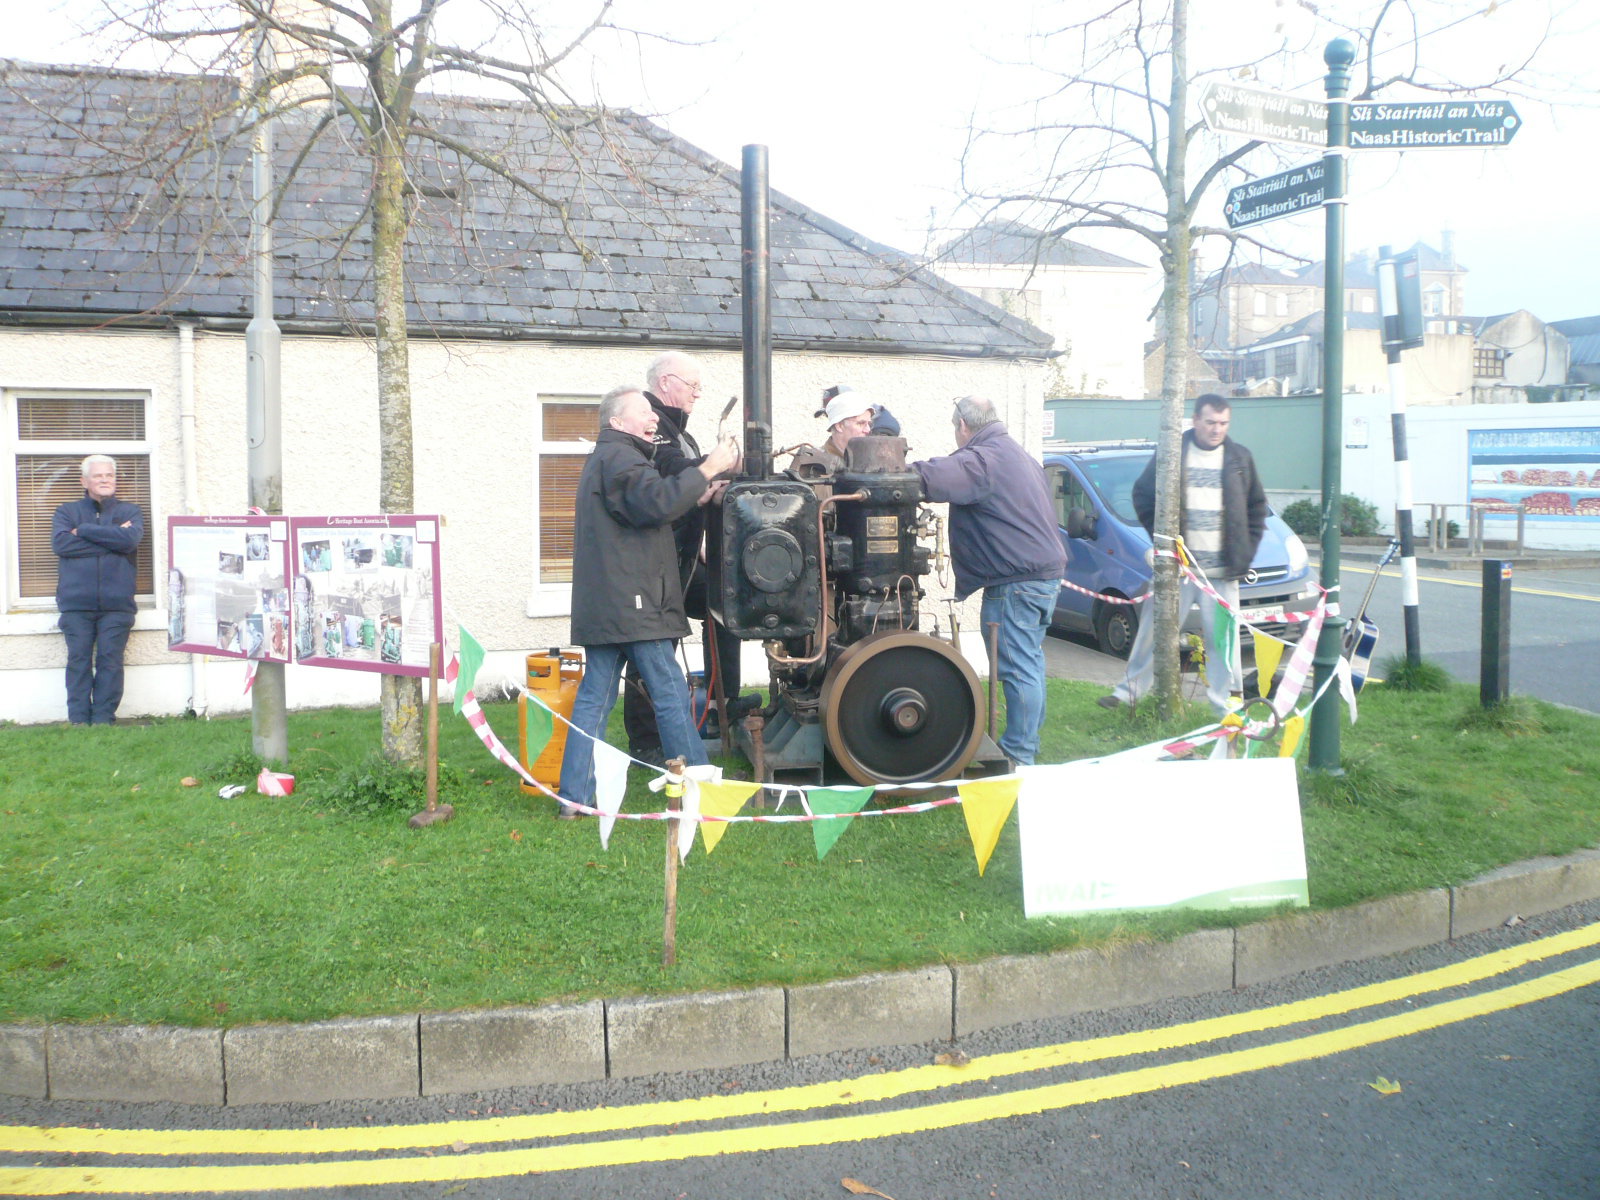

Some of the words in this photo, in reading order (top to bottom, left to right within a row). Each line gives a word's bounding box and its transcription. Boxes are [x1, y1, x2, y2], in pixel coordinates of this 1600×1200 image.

[1289, 103, 1305, 116] an
[1448, 106, 1468, 119] an
[1471, 102, 1504, 118] Nás
[1350, 130, 1391, 146] Naas
[1391, 129, 1462, 145] Historic
[1462, 127, 1505, 143] Trail
[1290, 174, 1303, 186] an
